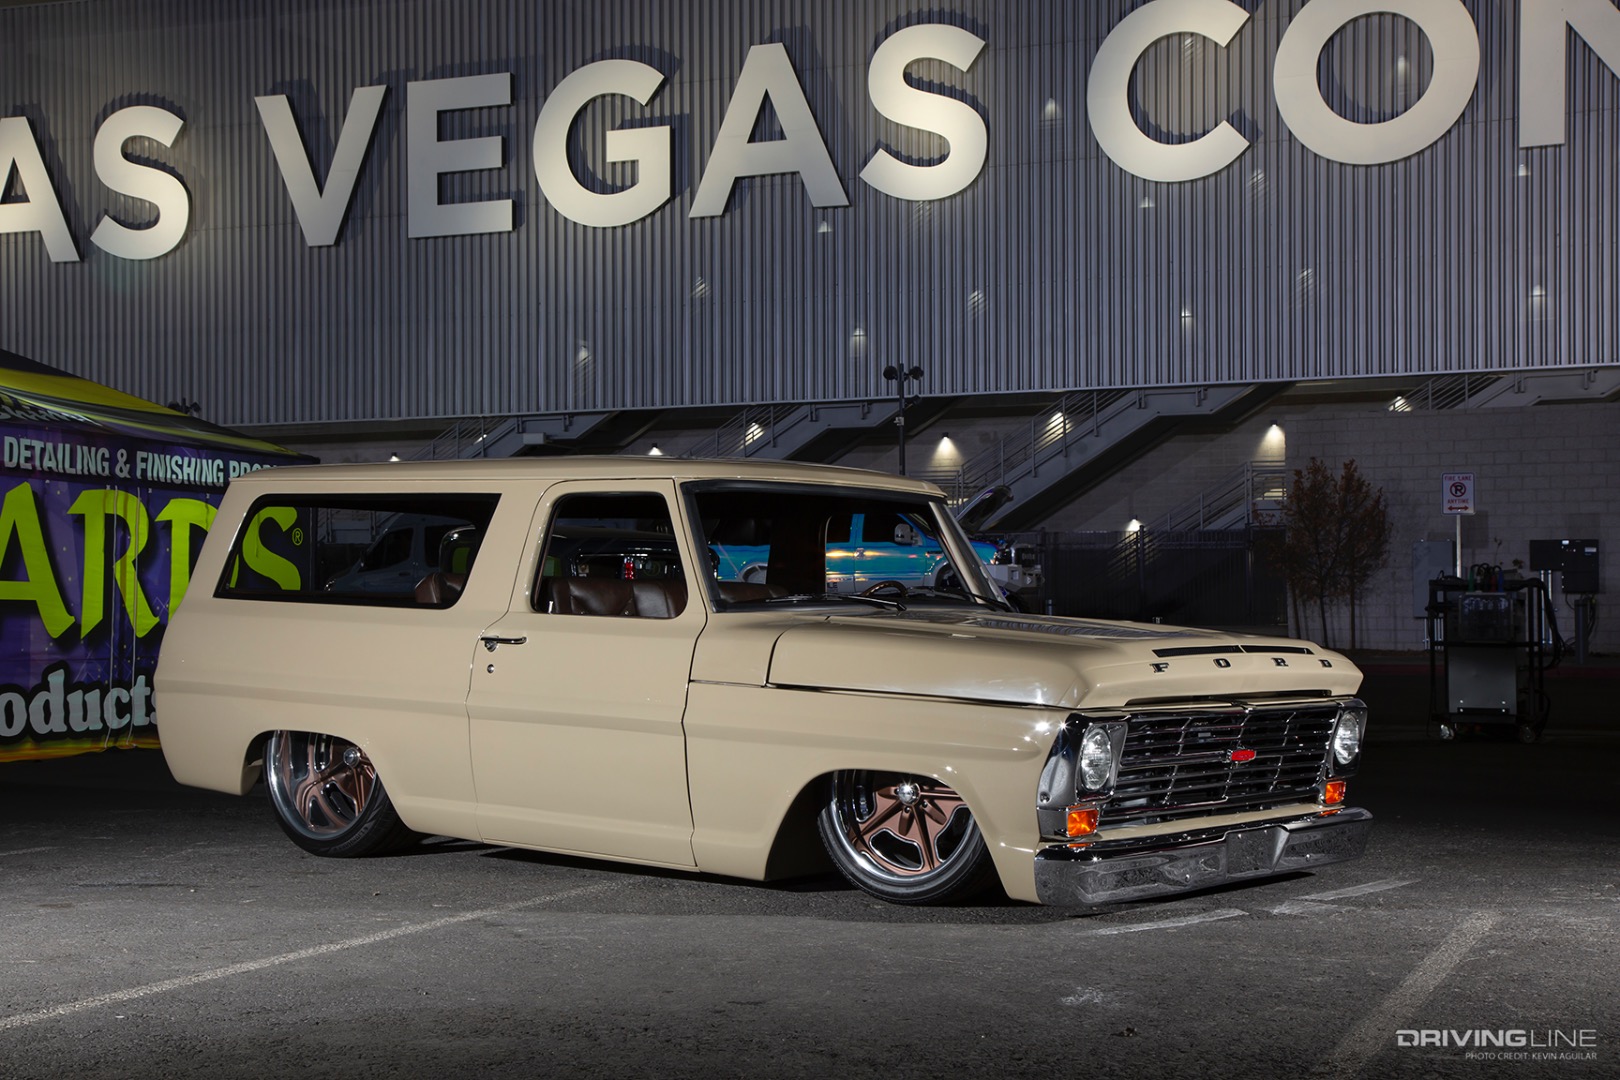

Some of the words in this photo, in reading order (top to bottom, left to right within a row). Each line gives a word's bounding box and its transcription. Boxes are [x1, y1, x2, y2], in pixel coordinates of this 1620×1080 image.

[254, 23, 988, 248] VEGAS
[4, 436, 110, 476] DETAILING
[115, 448, 131, 478] &
[136, 451, 224, 487] FINISHING
[1150, 657, 1333, 673] FORD
